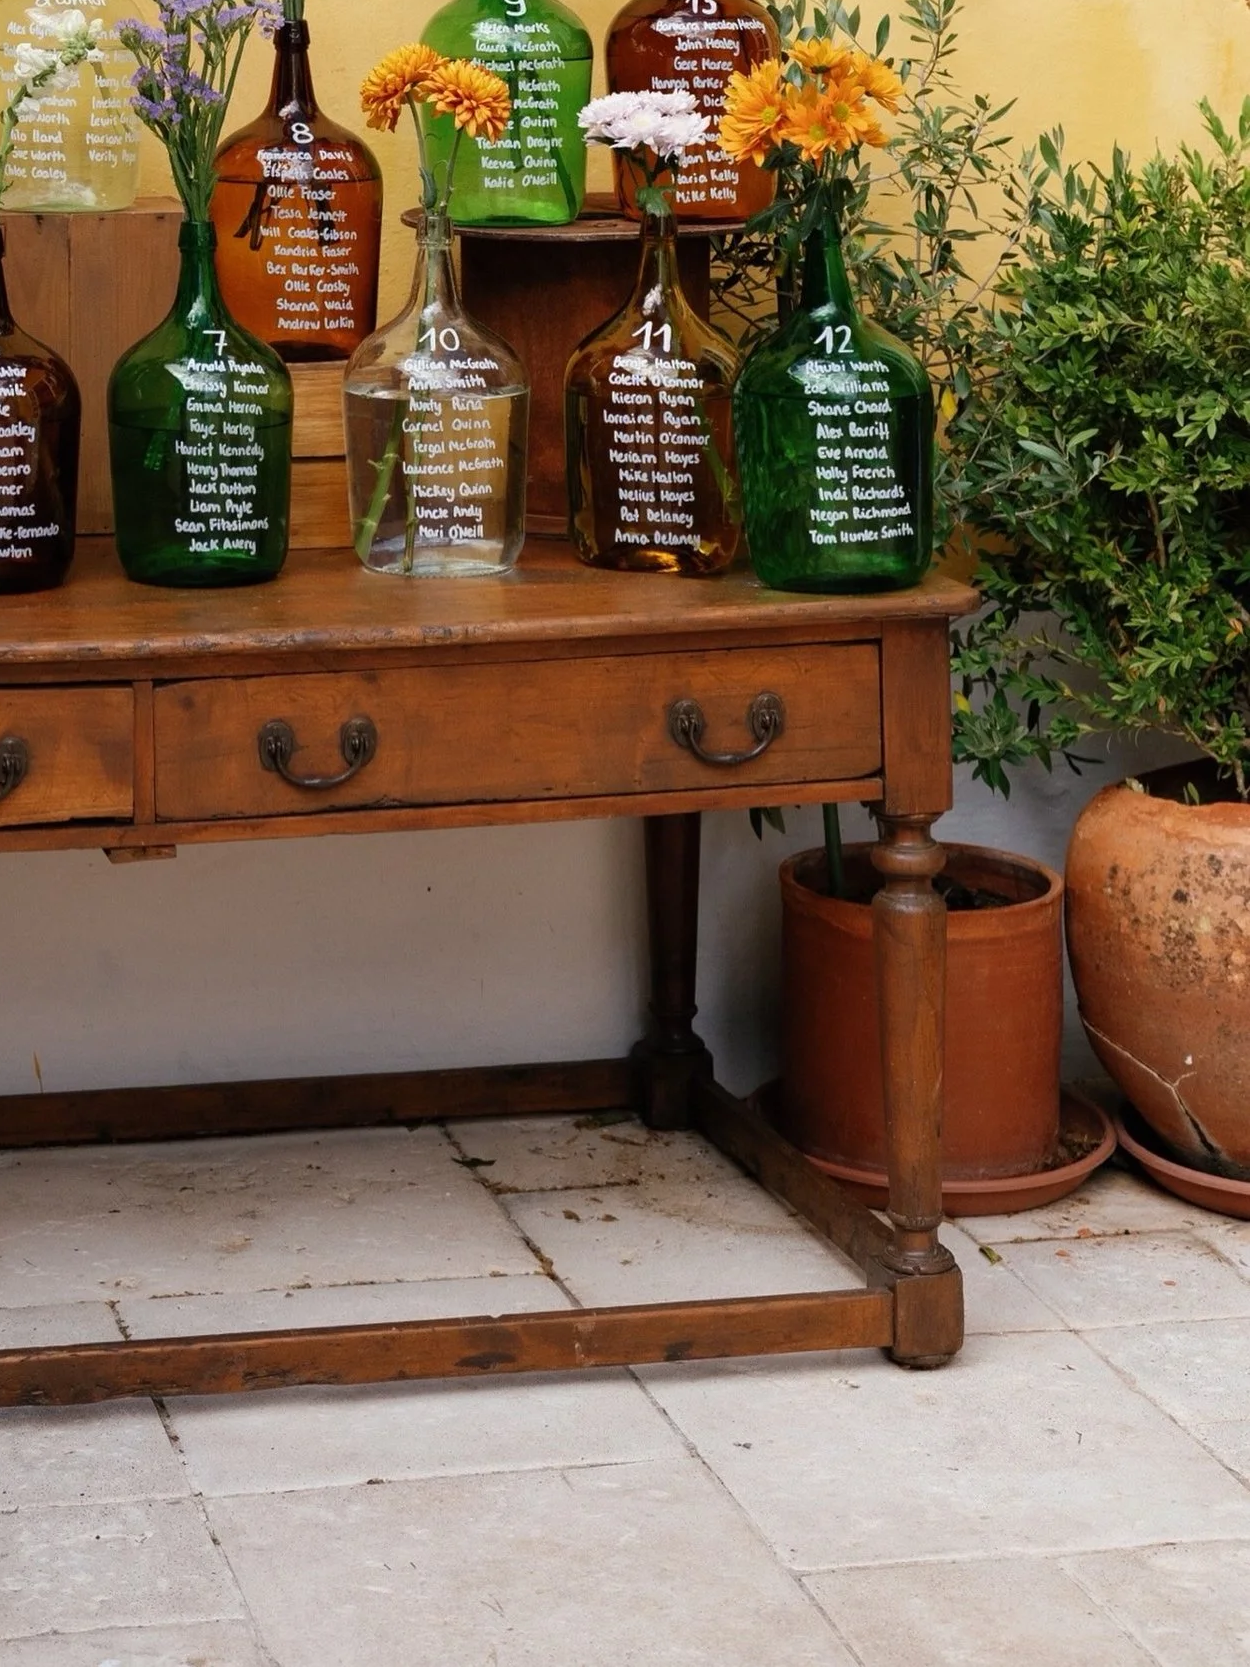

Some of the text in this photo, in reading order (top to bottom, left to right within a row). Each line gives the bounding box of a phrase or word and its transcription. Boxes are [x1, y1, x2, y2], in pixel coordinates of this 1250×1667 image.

[513, 22, 551, 35] Marks
[475, 39, 562, 54] Laura McGrath
[675, 37, 741, 56] John Healey
[517, 56, 566, 72] McGrath
[517, 78, 561, 93] McGrath
[692, 76, 724, 90] Parker
[513, 96, 559, 111] McGrath
[520, 115, 558, 129] Quinn
[290, 122, 315, 145] 8
[318, 149, 354, 163] Davis
[523, 154, 558, 169] Quinn
[483, 172, 558, 189] Katie O'Neill
[709, 169, 740, 185] Kelly
[267, 184, 337, 201] Ollie Fraser
[675, 187, 737, 204] Mike Kelly
[270, 204, 304, 220] Tessa
[260, 225, 281, 238] Will
[266, 260, 287, 276] Bex
[284, 278, 351, 297] Ollie Crosby
[277, 314, 355, 331] Andrew Larkin
[202, 330, 228, 356] 7
[418, 327, 460, 352] 10
[631, 321, 673, 353] 11
[813, 324, 855, 355] 12
[449, 357, 499, 371] McGrath
[849, 360, 891, 374] Worth
[233, 380, 269, 396] Kumar
[444, 374, 487, 390] Smith
[186, 397, 225, 413] Emma
[611, 390, 696, 408] Kieran Ryan
[808, 400, 852, 417] Shane
[190, 418, 218, 440] Faye
[401, 417, 492, 433] Carmel Quinn
[662, 411, 702, 430] Ryan
[613, 430, 655, 445] Martin
[815, 422, 845, 440] Alex
[175, 439, 264, 463] Harriet Kennedy
[412, 436, 496, 459] Fergal McGrath
[817, 445, 890, 461] Eve Arnold
[458, 456, 505, 472] McGrath
[665, 450, 701, 469] Hayes
[186, 461, 258, 481] Henry Thomas
[619, 468, 649, 483] Mike
[815, 464, 897, 485] Holly French
[188, 478, 217, 495] Jack
[412, 482, 493, 503] Mickey Quinn
[851, 484, 906, 502] Richards
[618, 487, 697, 507] Nelius Hayes
[189, 498, 221, 514] Liam
[415, 504, 483, 523] Uncle Andy
[809, 501, 912, 528] Megan Richmond
[174, 518, 206, 533] Sean
[620, 505, 695, 529] Pat Delaney
[447, 523, 484, 540] O'Neill
[808, 522, 915, 545] Tom Smith
[188, 537, 257, 556] Jack Avery
[653, 529, 702, 552] Delaney
